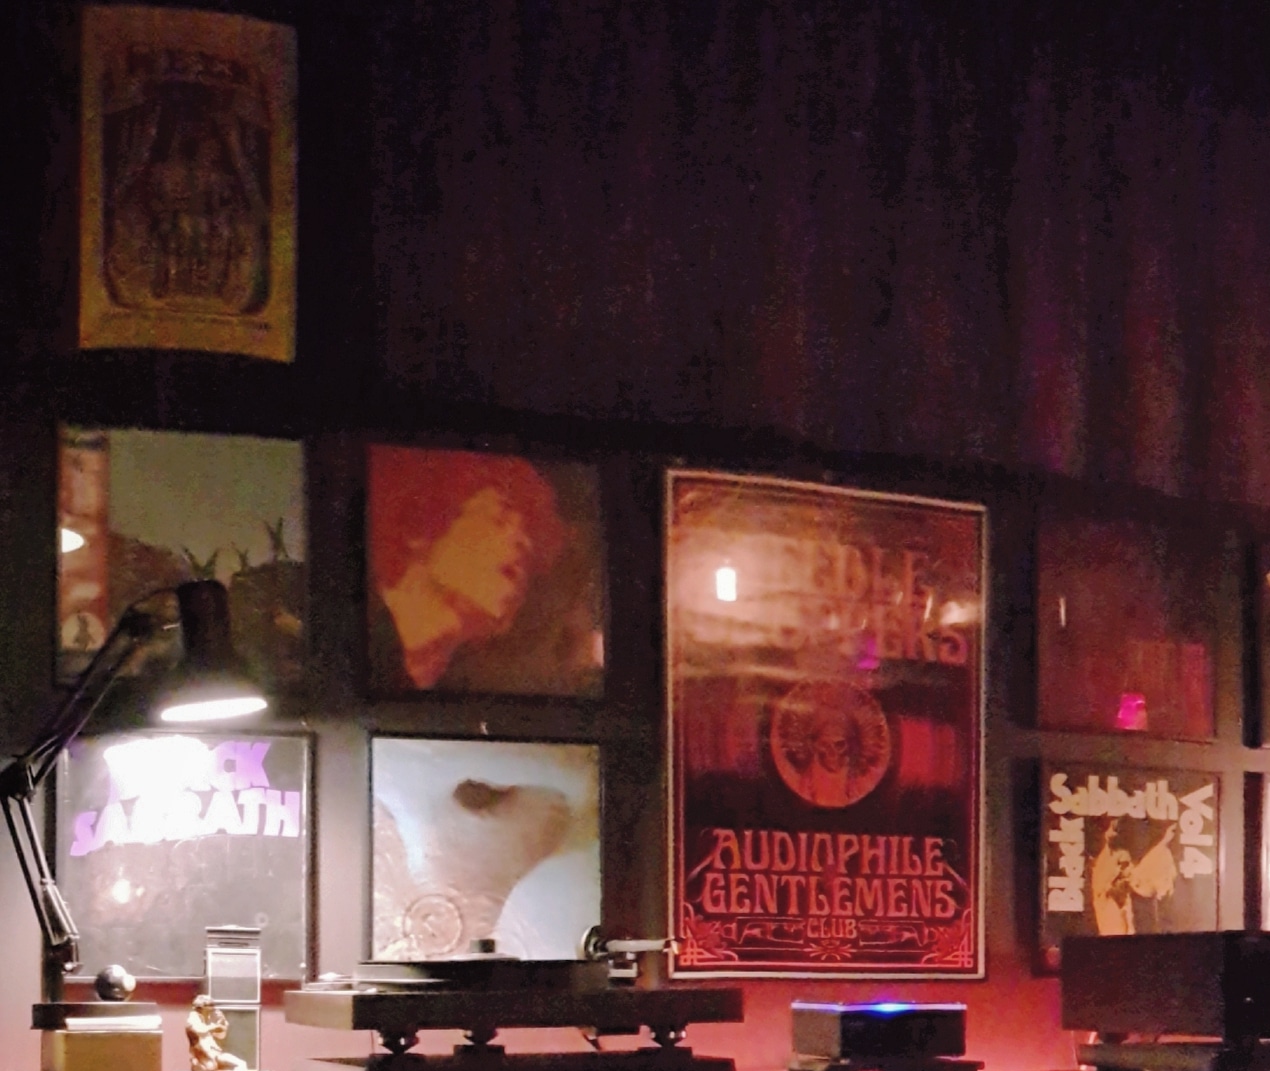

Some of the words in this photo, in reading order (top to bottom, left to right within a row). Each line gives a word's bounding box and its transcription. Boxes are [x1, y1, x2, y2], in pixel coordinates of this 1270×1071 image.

[1048, 773, 1179, 821] Sabbath
[712, 828, 945, 876] AUDIOPHILE
[1048, 816, 1085, 912] Black
[702, 872, 956, 918] GENTLEMENS
[806, 917, 858, 939] CLUB
